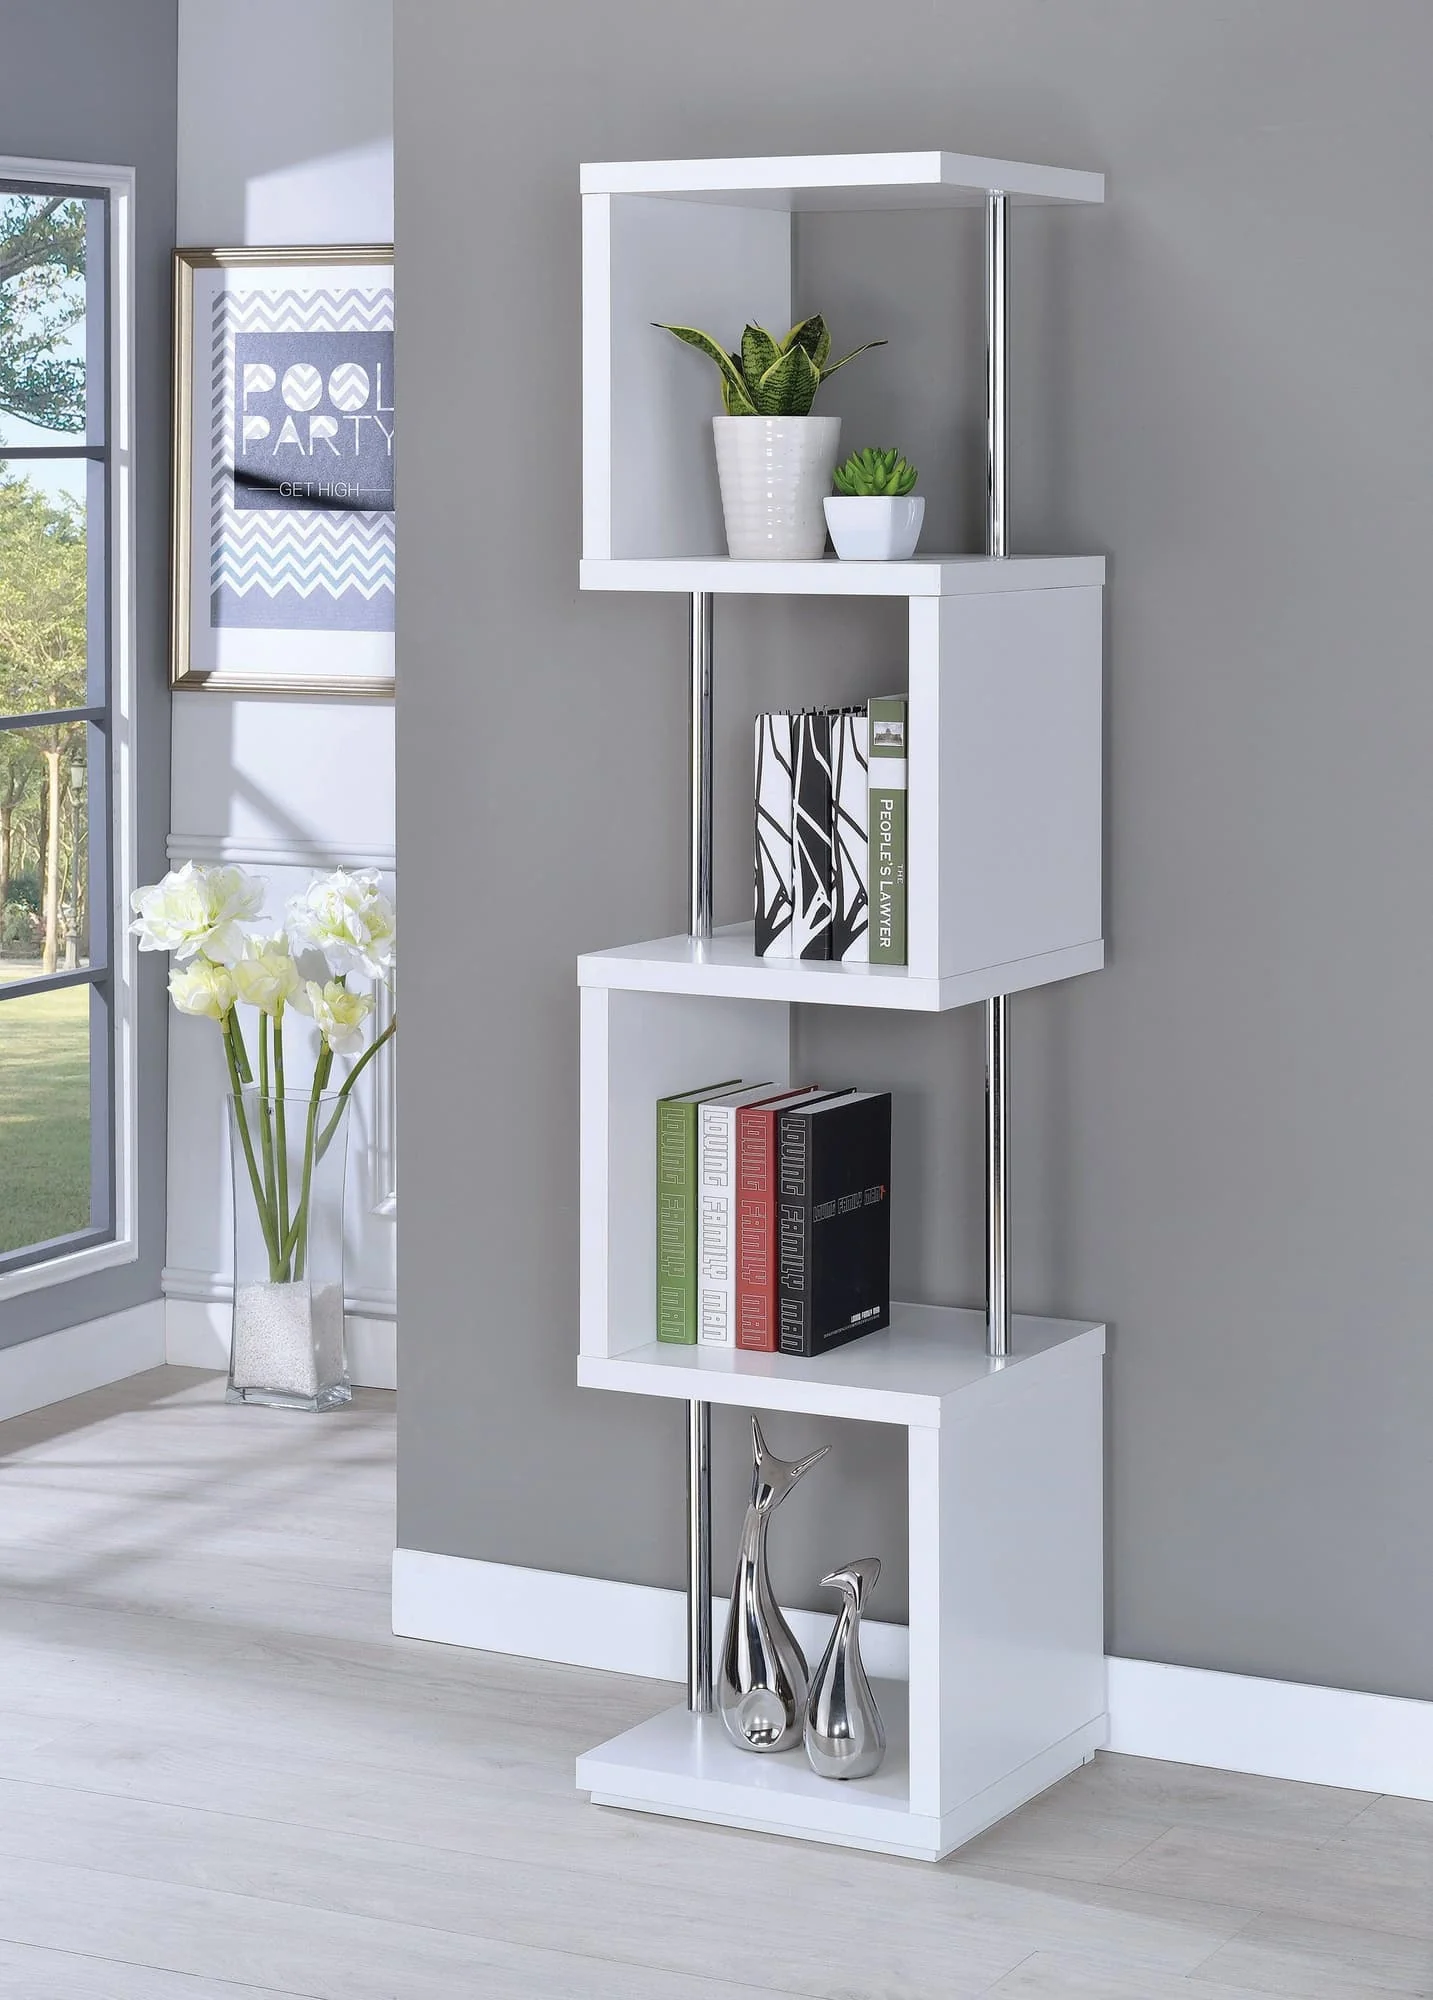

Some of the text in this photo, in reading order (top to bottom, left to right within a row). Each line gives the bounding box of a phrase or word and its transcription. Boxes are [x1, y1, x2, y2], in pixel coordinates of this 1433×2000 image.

[243, 363, 394, 412] POOL
[242, 415, 394, 456] PARTY
[279, 481, 360, 497] GET HIGH
[879, 799, 893, 948] PEOPLE'S LAWYER
[661, 1193, 685, 1277] FAMILY
[703, 1196, 728, 1280] FAMILY
[741, 1200, 767, 1285] FAMILY
[781, 1204, 805, 1290] FAMILY
[661, 1286, 685, 1338] MAN
[703, 1289, 728, 1341] MAN
[741, 1294, 767, 1346] MAN
[781, 1298, 805, 1352] MAN
